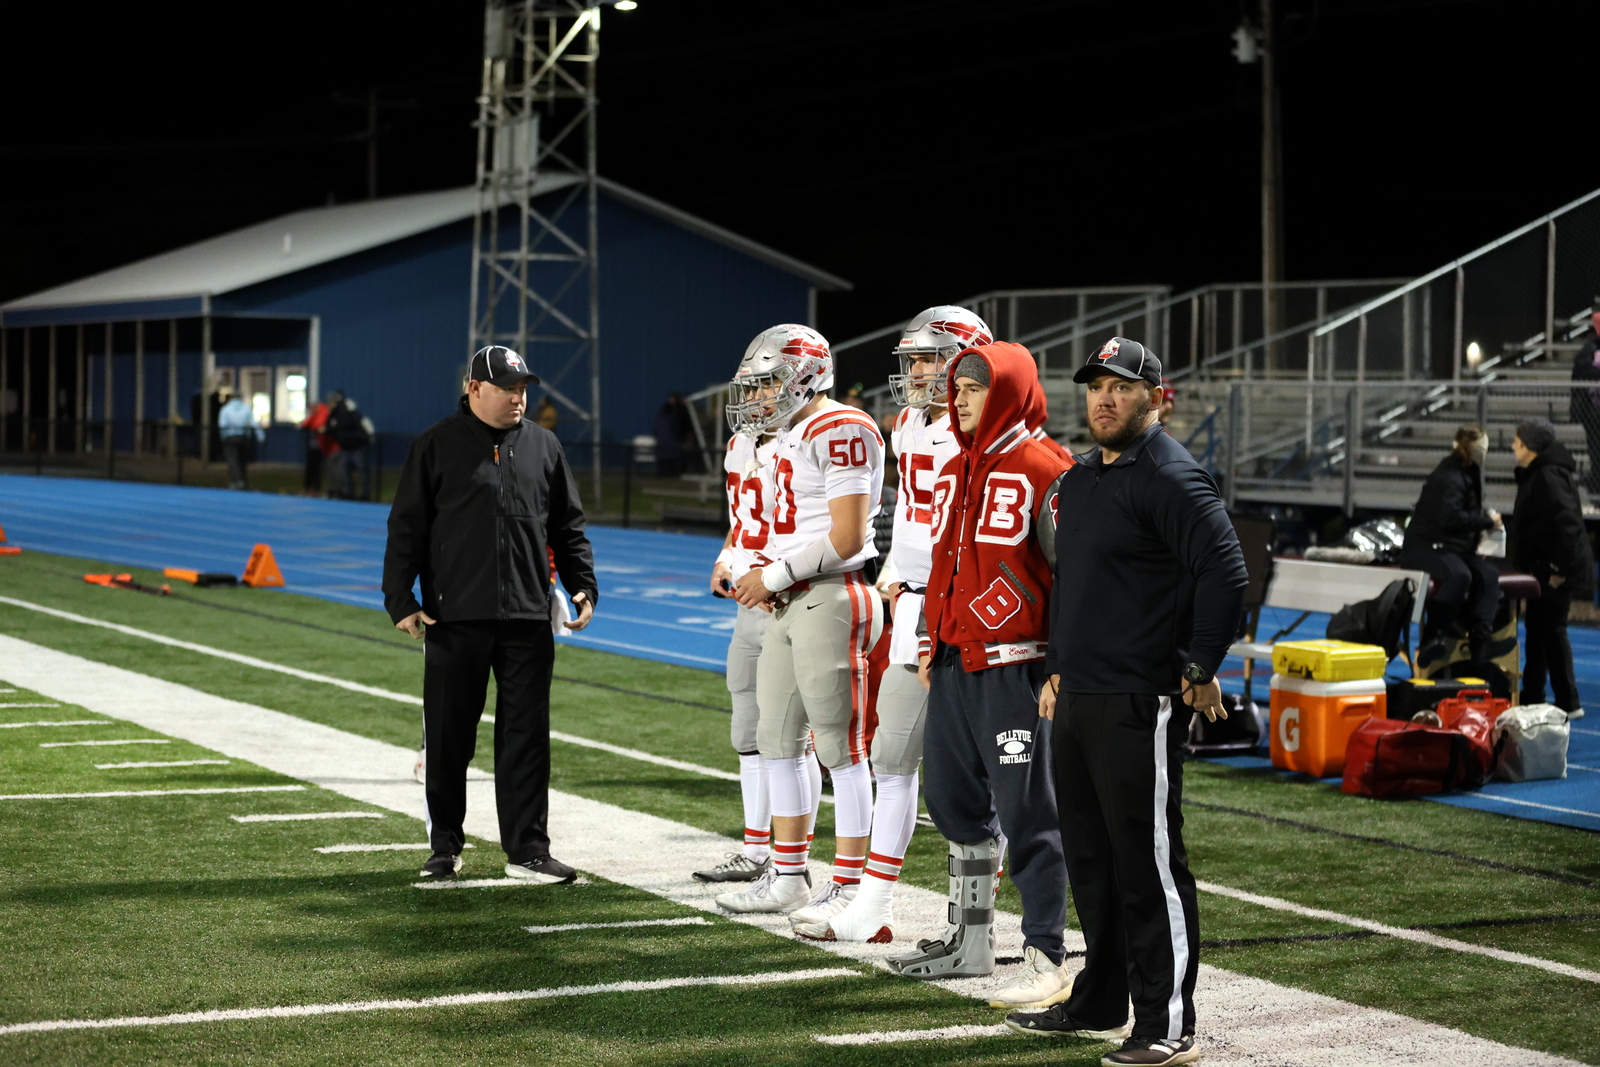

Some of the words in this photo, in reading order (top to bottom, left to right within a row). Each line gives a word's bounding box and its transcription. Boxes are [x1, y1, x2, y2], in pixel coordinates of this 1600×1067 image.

[828, 437, 867, 467] 50
[975, 472, 1034, 546] B
[969, 576, 1021, 629] B
[1008, 647, 1029, 657] Evan
[996, 729, 1032, 747] BELLEVUE
[1279, 707, 1300, 752] G
[999, 753, 1032, 765] FOOTBALL
